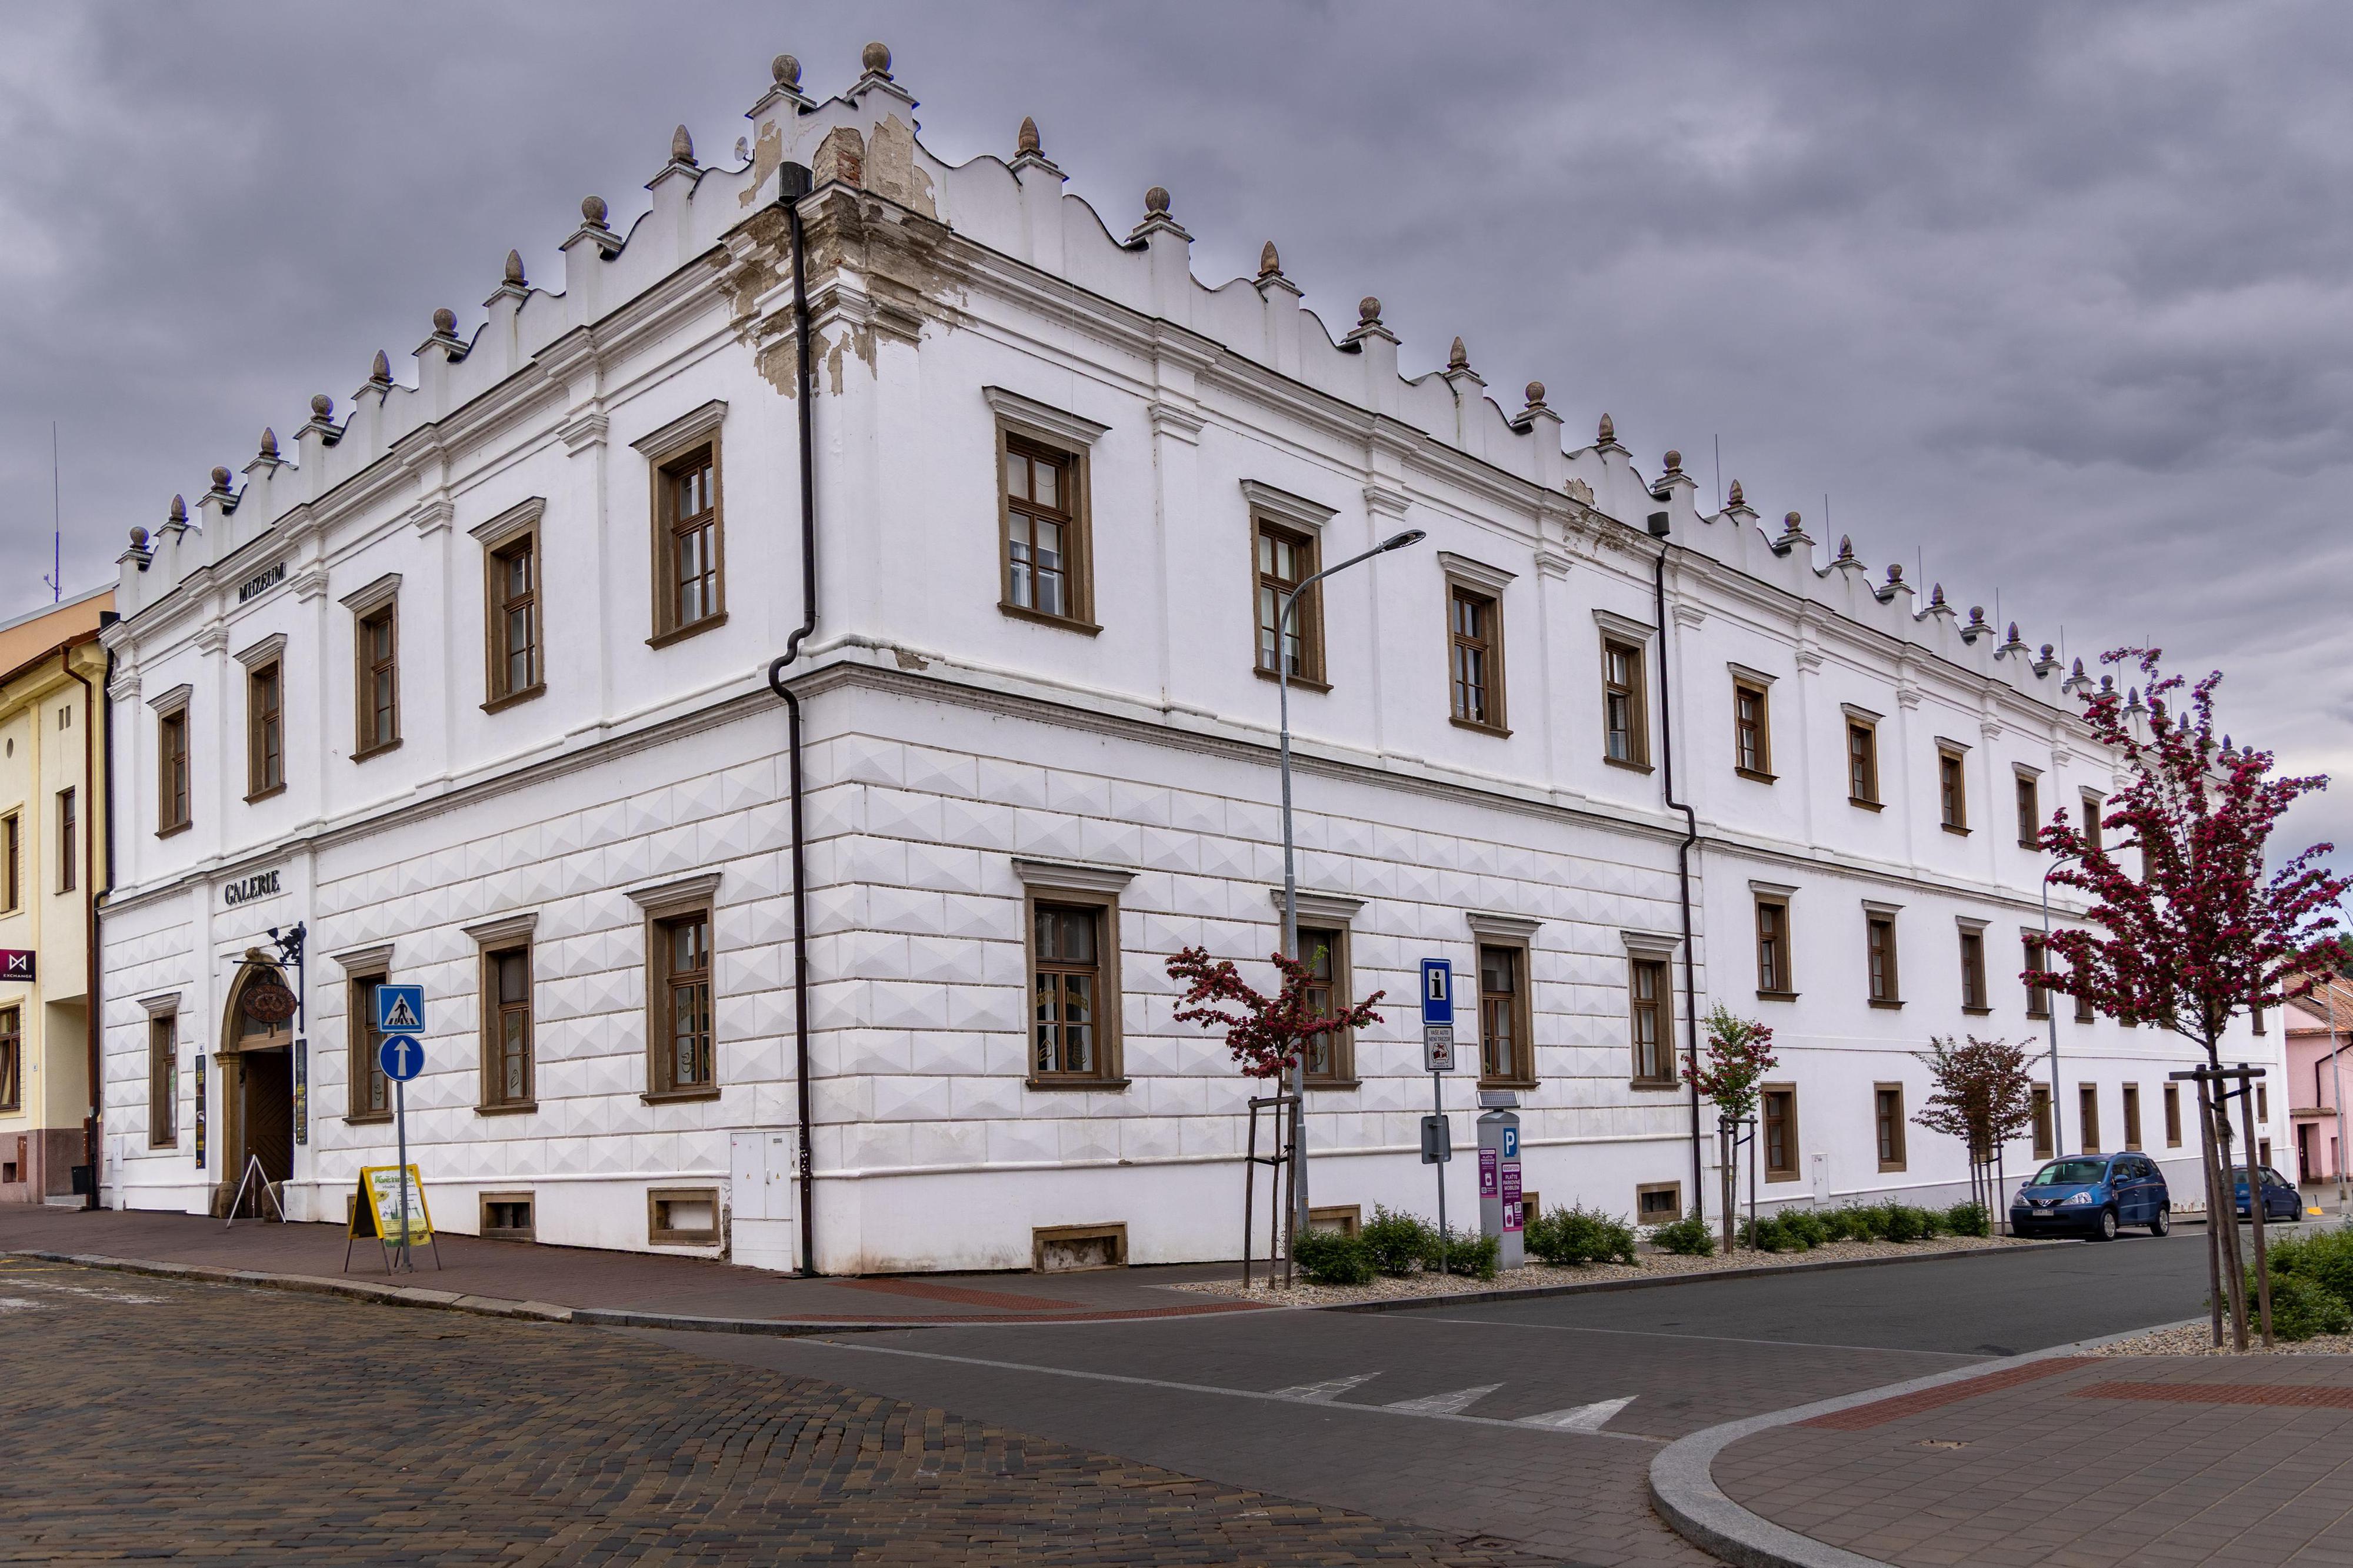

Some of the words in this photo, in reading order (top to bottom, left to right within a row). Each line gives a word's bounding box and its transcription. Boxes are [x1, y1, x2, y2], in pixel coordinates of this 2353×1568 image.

[239, 562, 284, 603] MUZEUM
[225, 870, 280, 905] GALERIE
[1506, 1132, 1515, 1154] P
